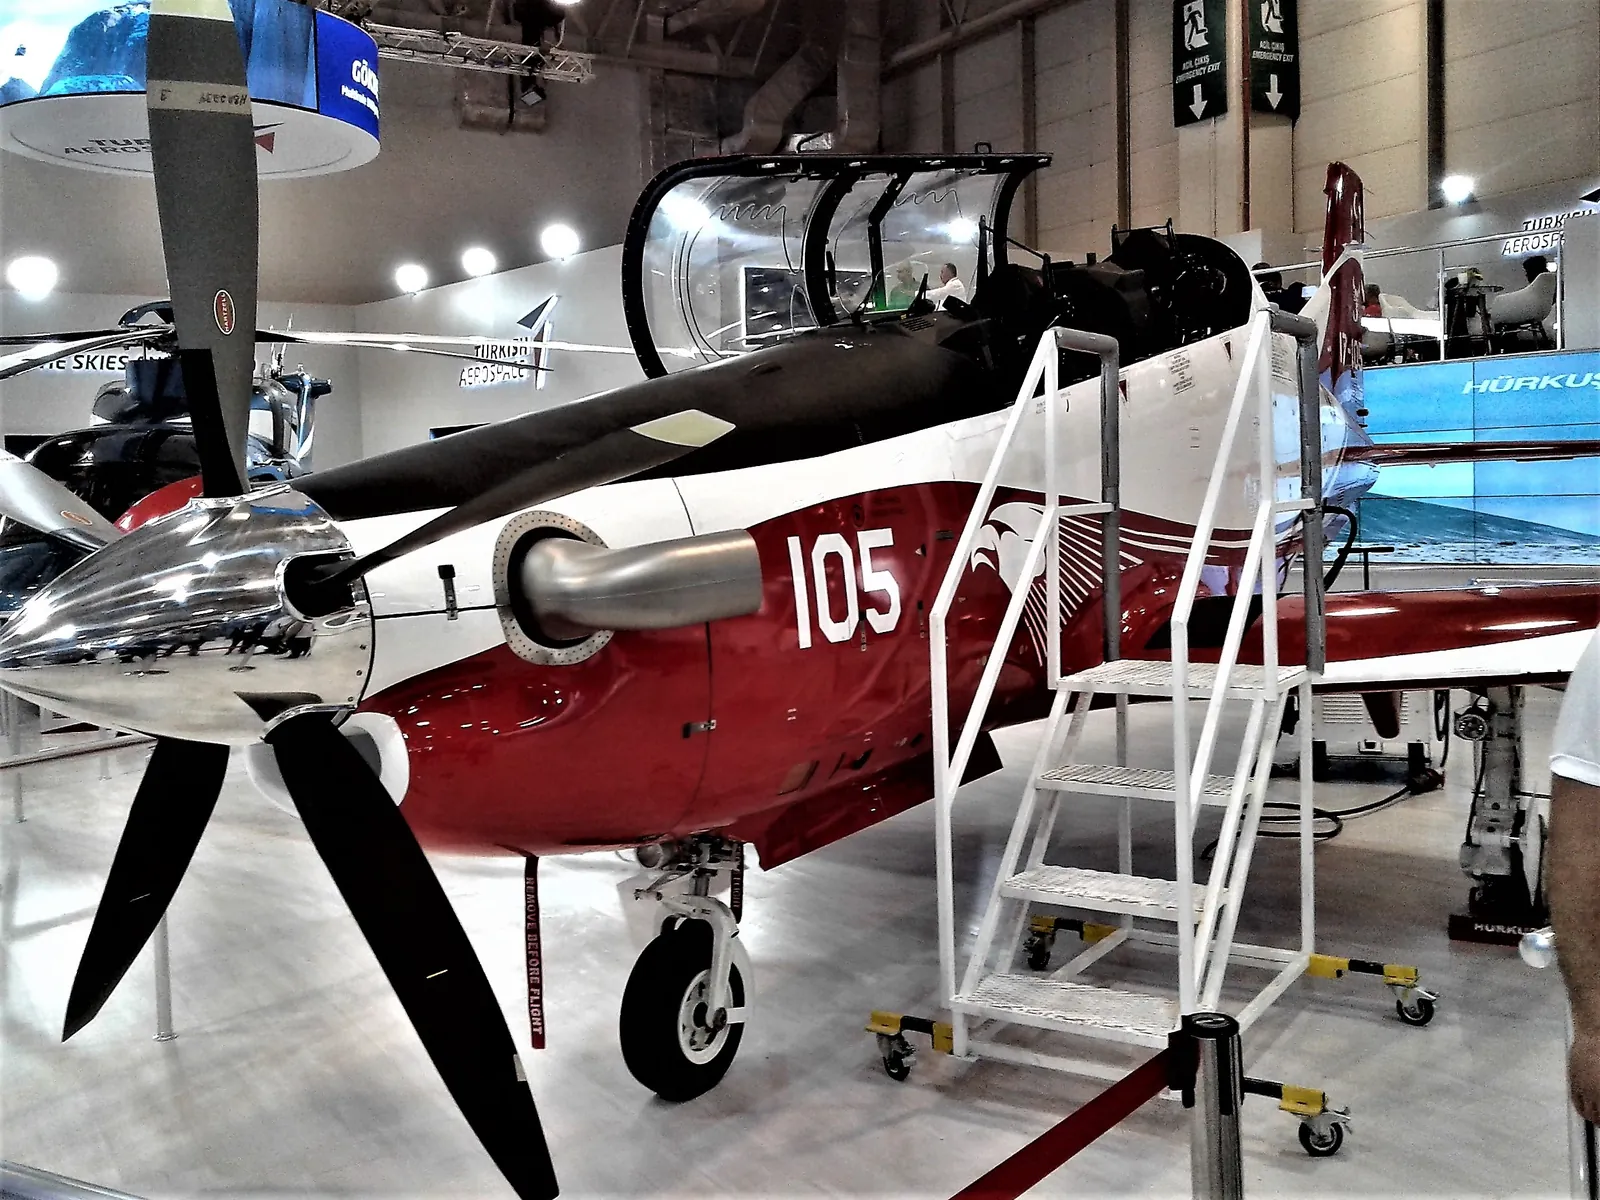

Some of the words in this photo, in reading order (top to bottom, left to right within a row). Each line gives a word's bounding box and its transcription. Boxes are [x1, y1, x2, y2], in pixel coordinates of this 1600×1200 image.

[1175, 66, 1207, 84] EMERGENCY
[1207, 61, 1221, 73] EXIT
[1252, 50, 1282, 61] EMERGENCY
[1282, 54, 1294, 63] EXIT
[1523, 209, 1593, 232] TURK
[72, 354, 130, 371] SKIES
[787, 527, 902, 649] 105
[525, 877, 537, 930] REMOVE
[527, 933, 540, 984] BEFORE
[530, 988, 543, 1036] FLIGHT
